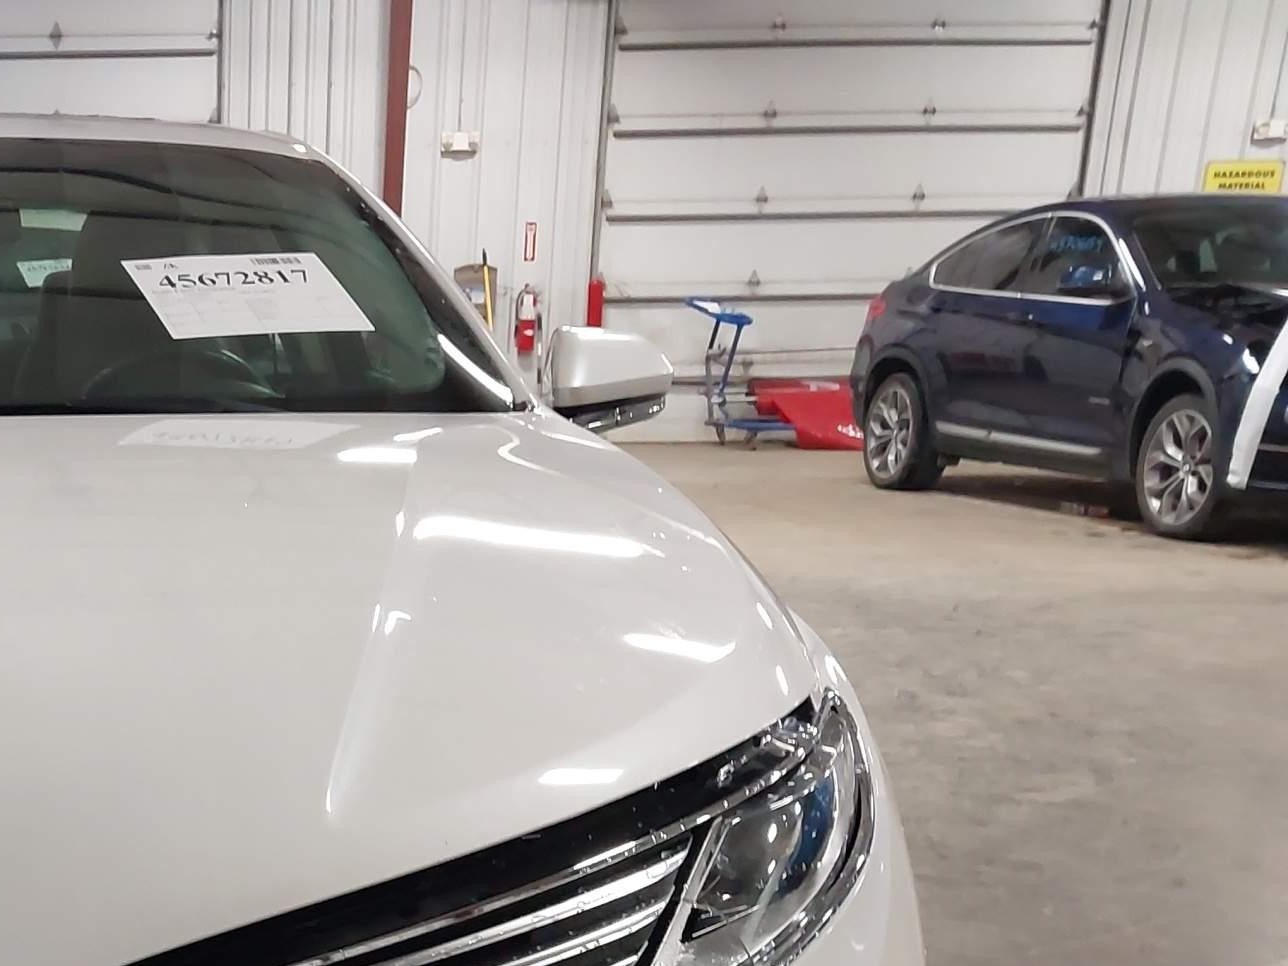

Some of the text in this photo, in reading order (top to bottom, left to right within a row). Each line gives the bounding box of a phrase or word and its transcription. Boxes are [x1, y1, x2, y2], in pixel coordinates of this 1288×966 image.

[1214, 170, 1275, 178] HAZARDOUS
[1219, 182, 1265, 190] MATERIAL
[159, 270, 308, 288] 45672817
